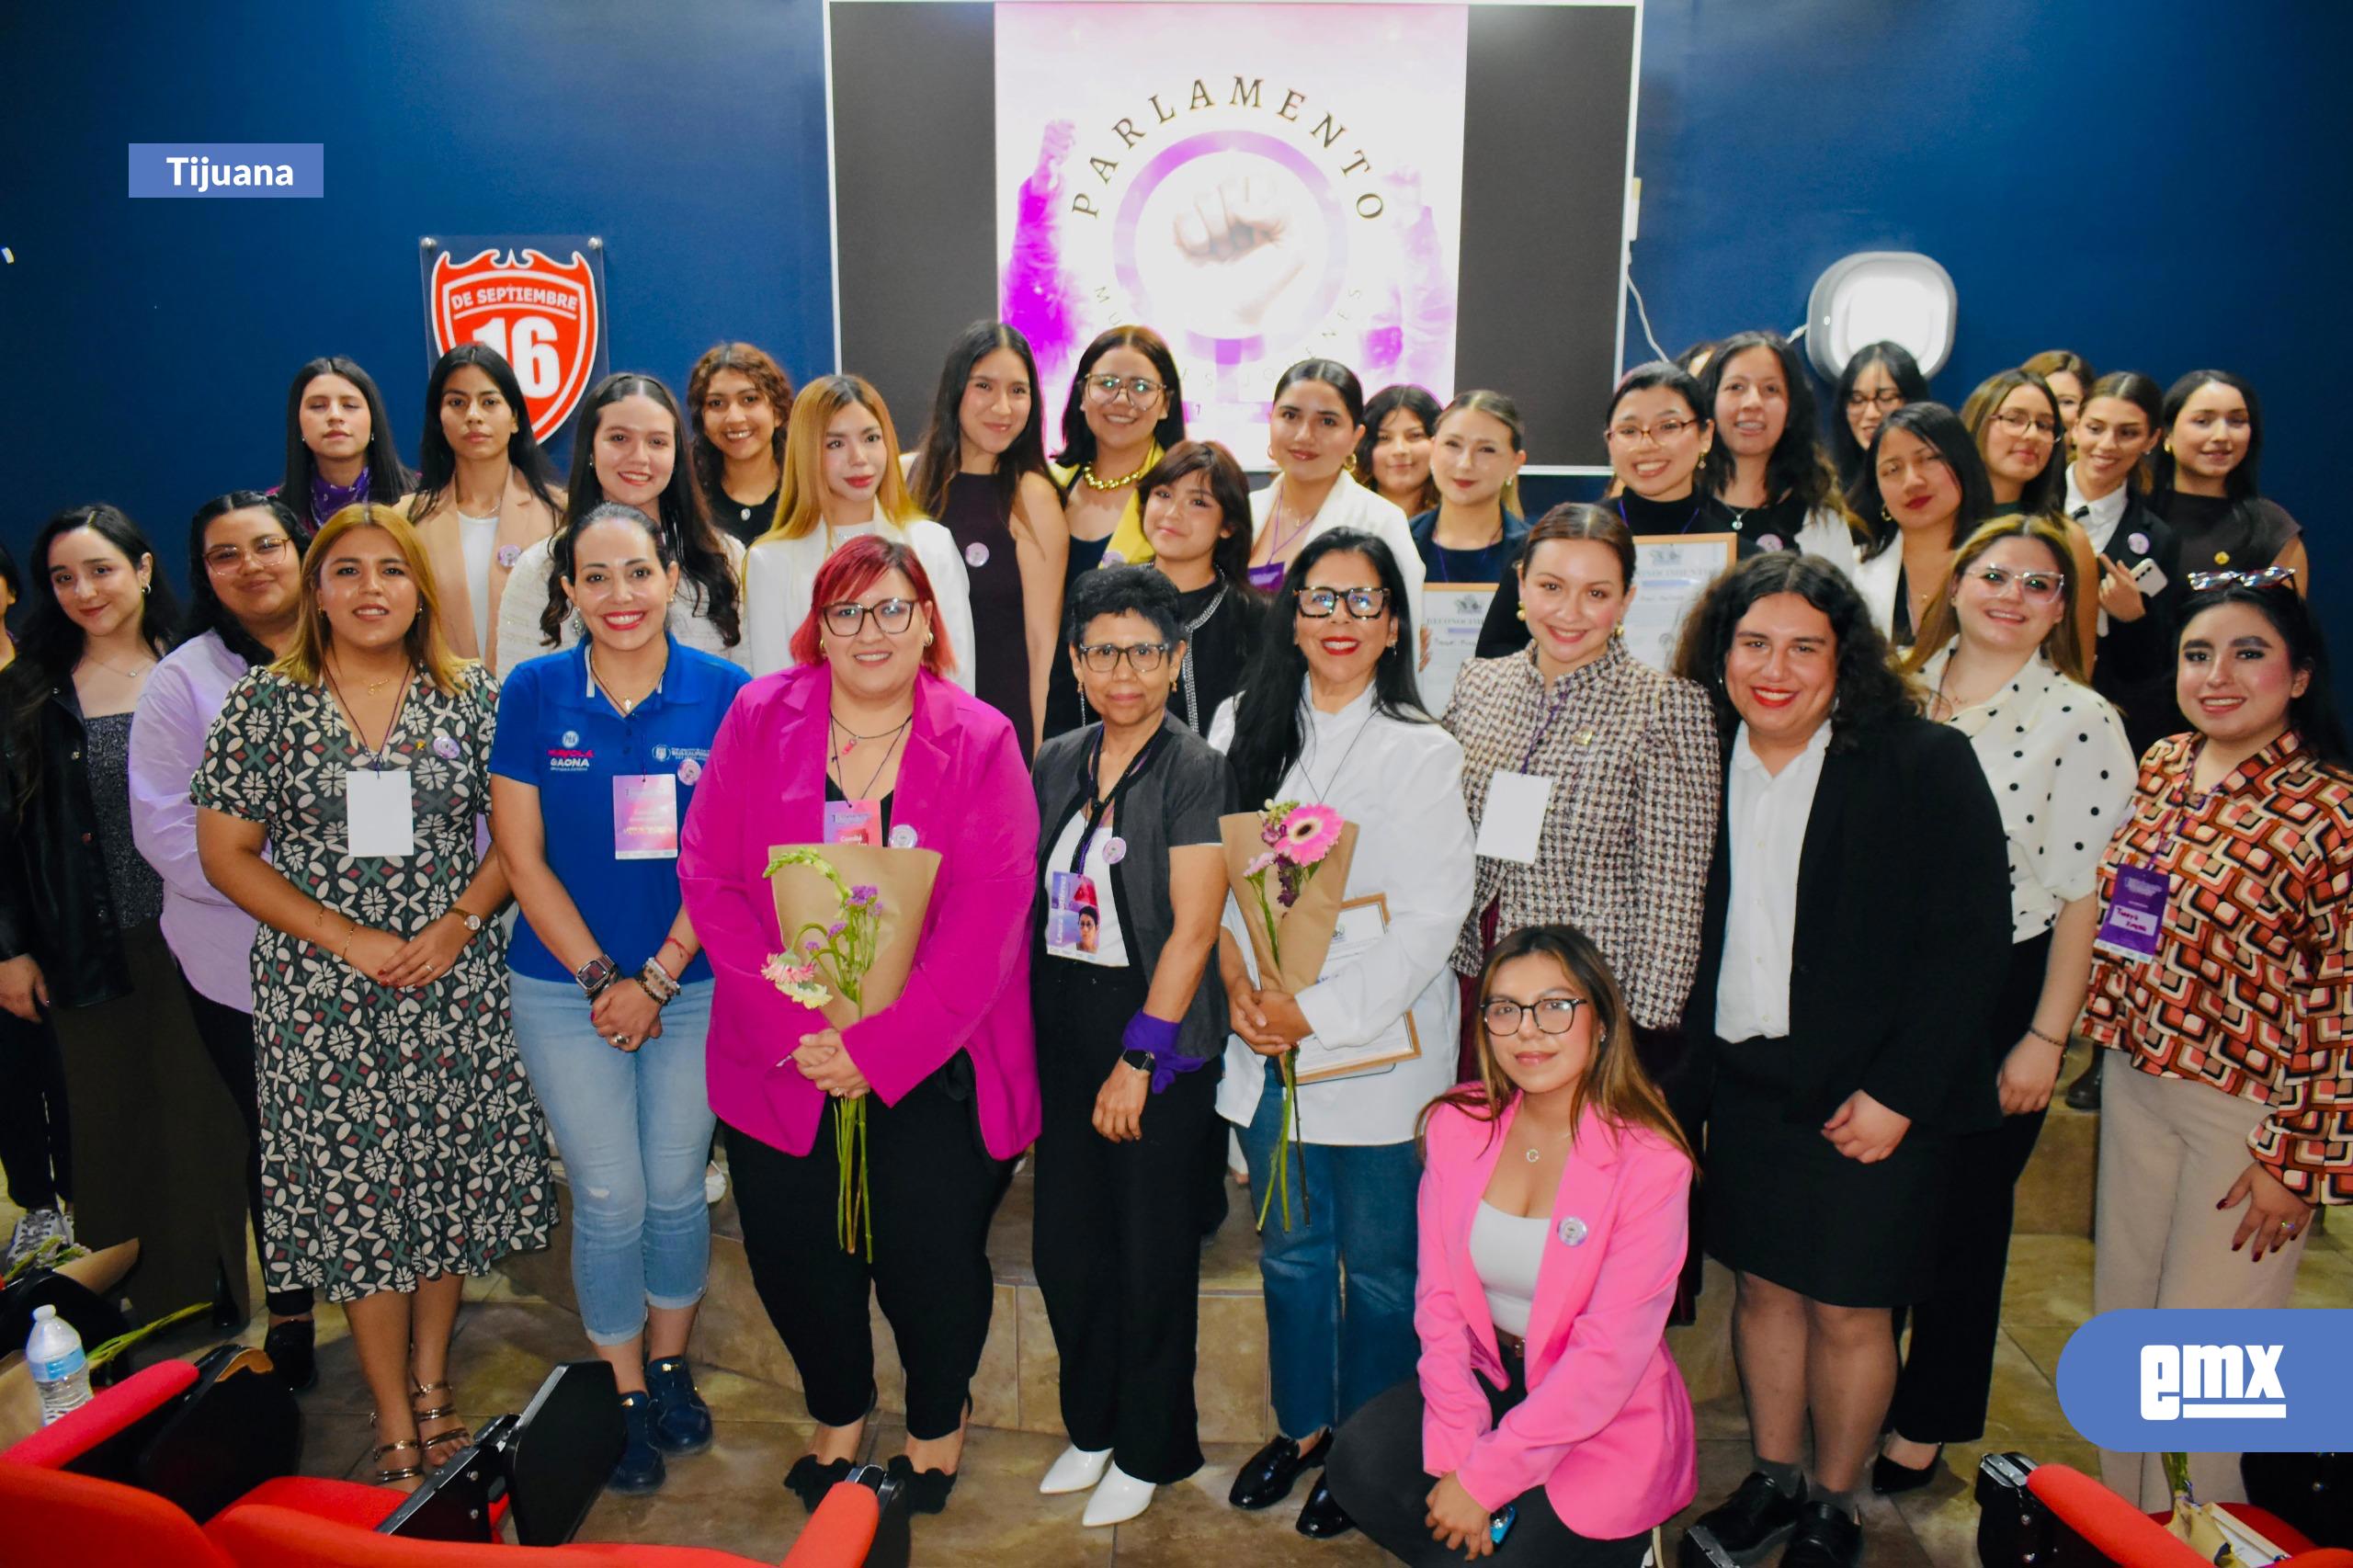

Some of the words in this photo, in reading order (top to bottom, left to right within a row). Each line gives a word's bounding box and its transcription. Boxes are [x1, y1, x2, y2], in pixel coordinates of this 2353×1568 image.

[1072, 76, 1383, 220] PARLAMENTO
[450, 290, 474, 311] DE
[476, 286, 578, 311] SEPTIEMBRE
[472, 316, 561, 399] 16
